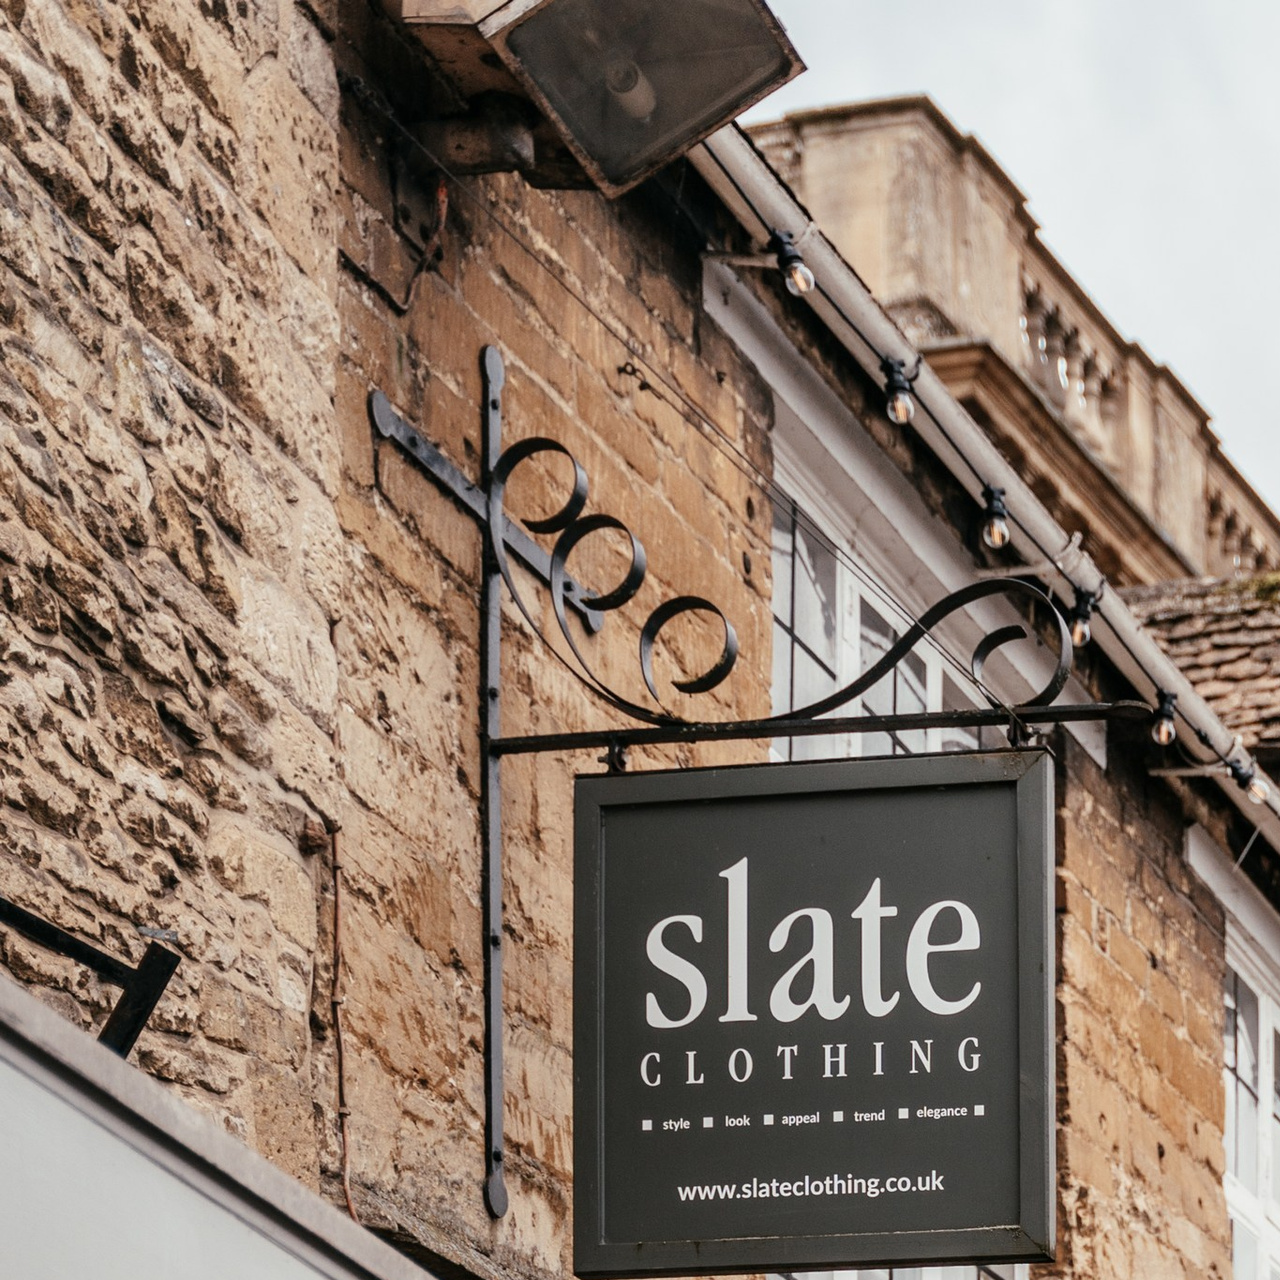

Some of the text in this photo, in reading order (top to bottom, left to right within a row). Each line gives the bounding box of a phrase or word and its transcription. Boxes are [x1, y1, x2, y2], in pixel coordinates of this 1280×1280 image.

[645, 856, 982, 1029] slate
[640, 1036, 983, 1087] CLOTHING
[662, 1105, 968, 1132] style look appeal trend elegance
[677, 1170, 945, 1202] www.slateclothing.co.uk
